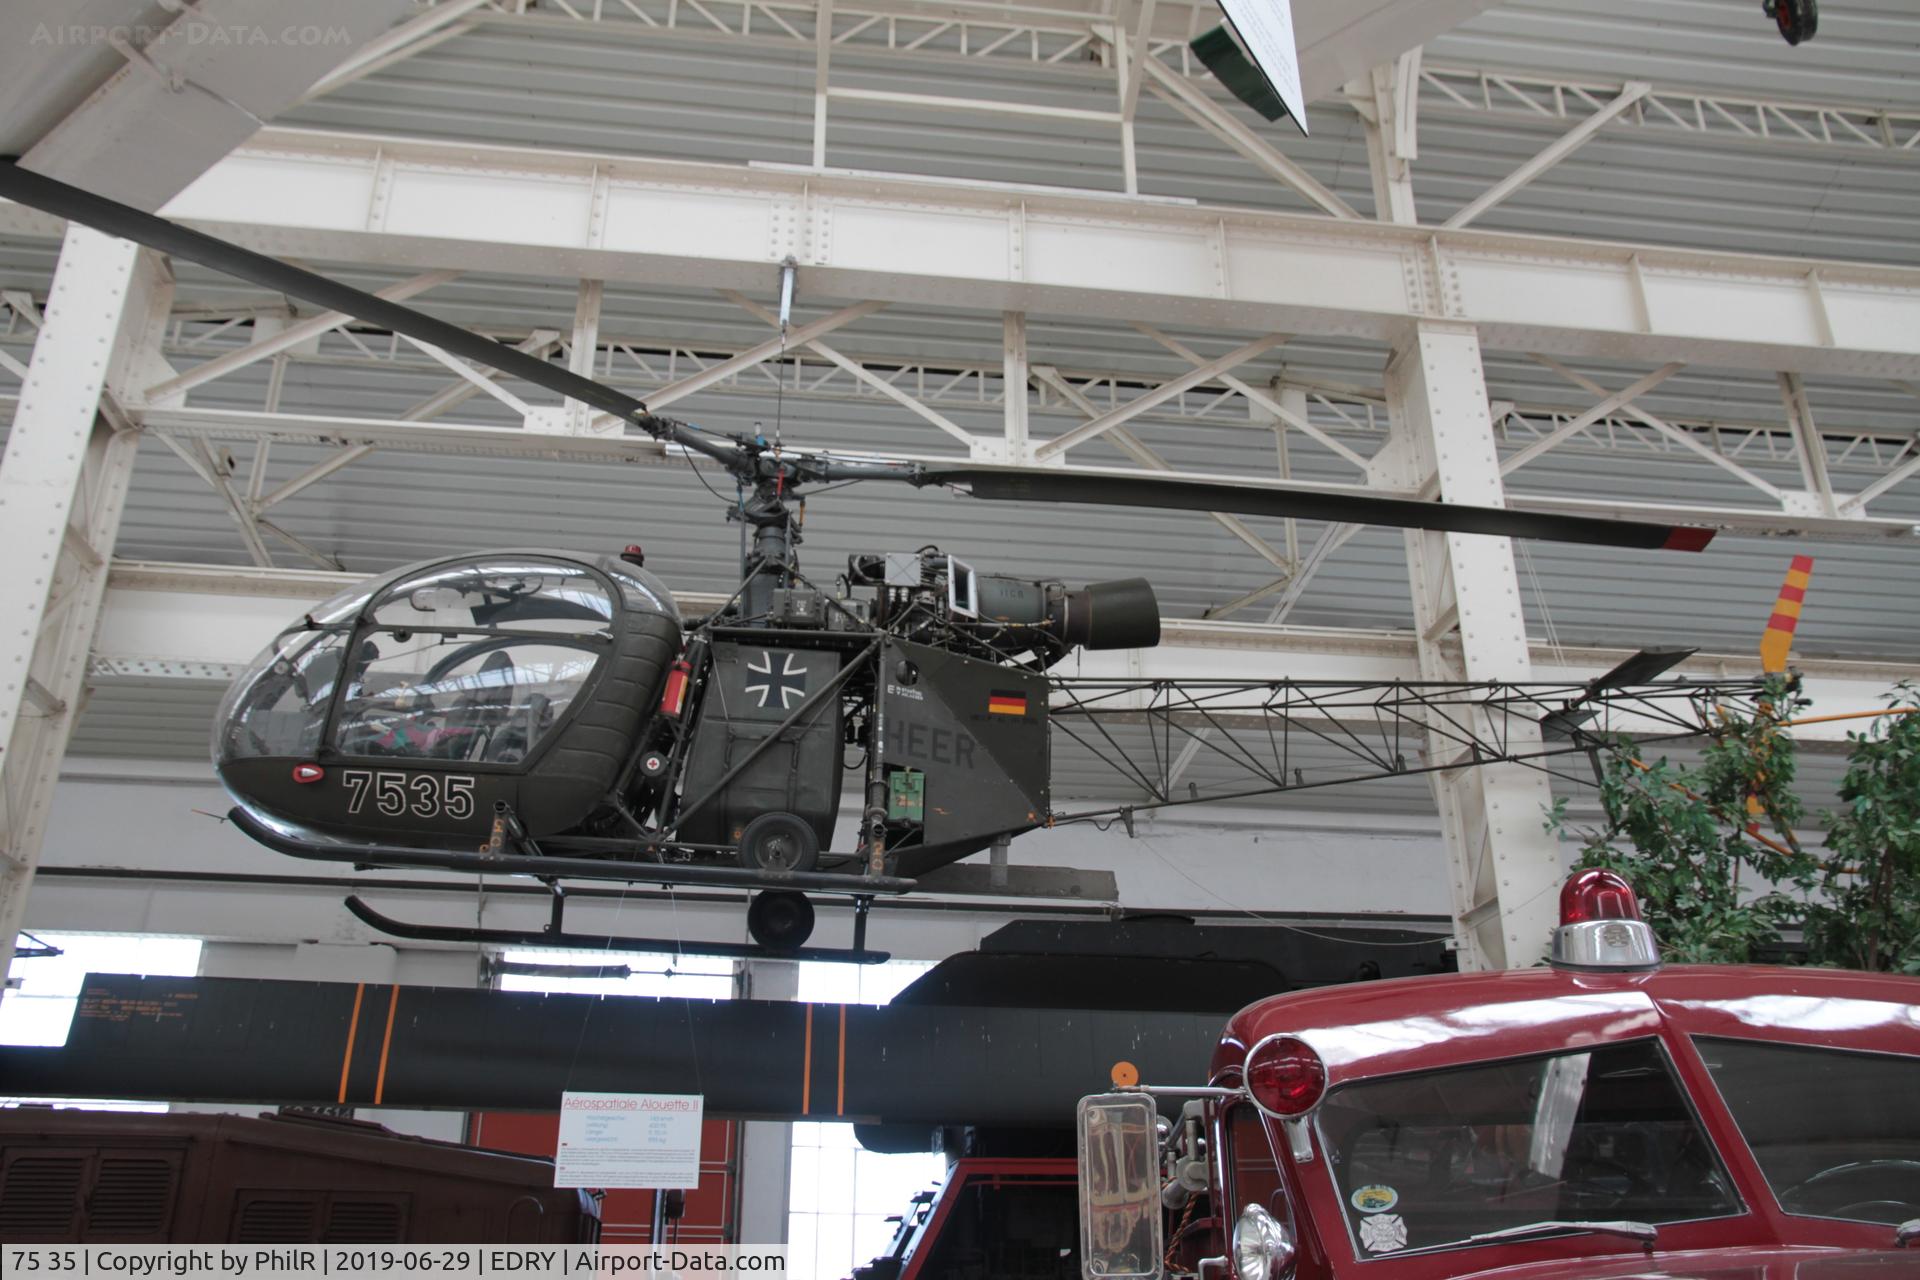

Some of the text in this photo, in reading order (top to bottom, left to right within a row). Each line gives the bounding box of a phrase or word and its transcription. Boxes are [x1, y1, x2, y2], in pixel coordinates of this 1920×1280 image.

[884, 720, 976, 770] HEER
[343, 770, 475, 820] 7535
[563, 1097, 638, 1111] Aérospatiale
[640, 1098, 690, 1111] Alouette
